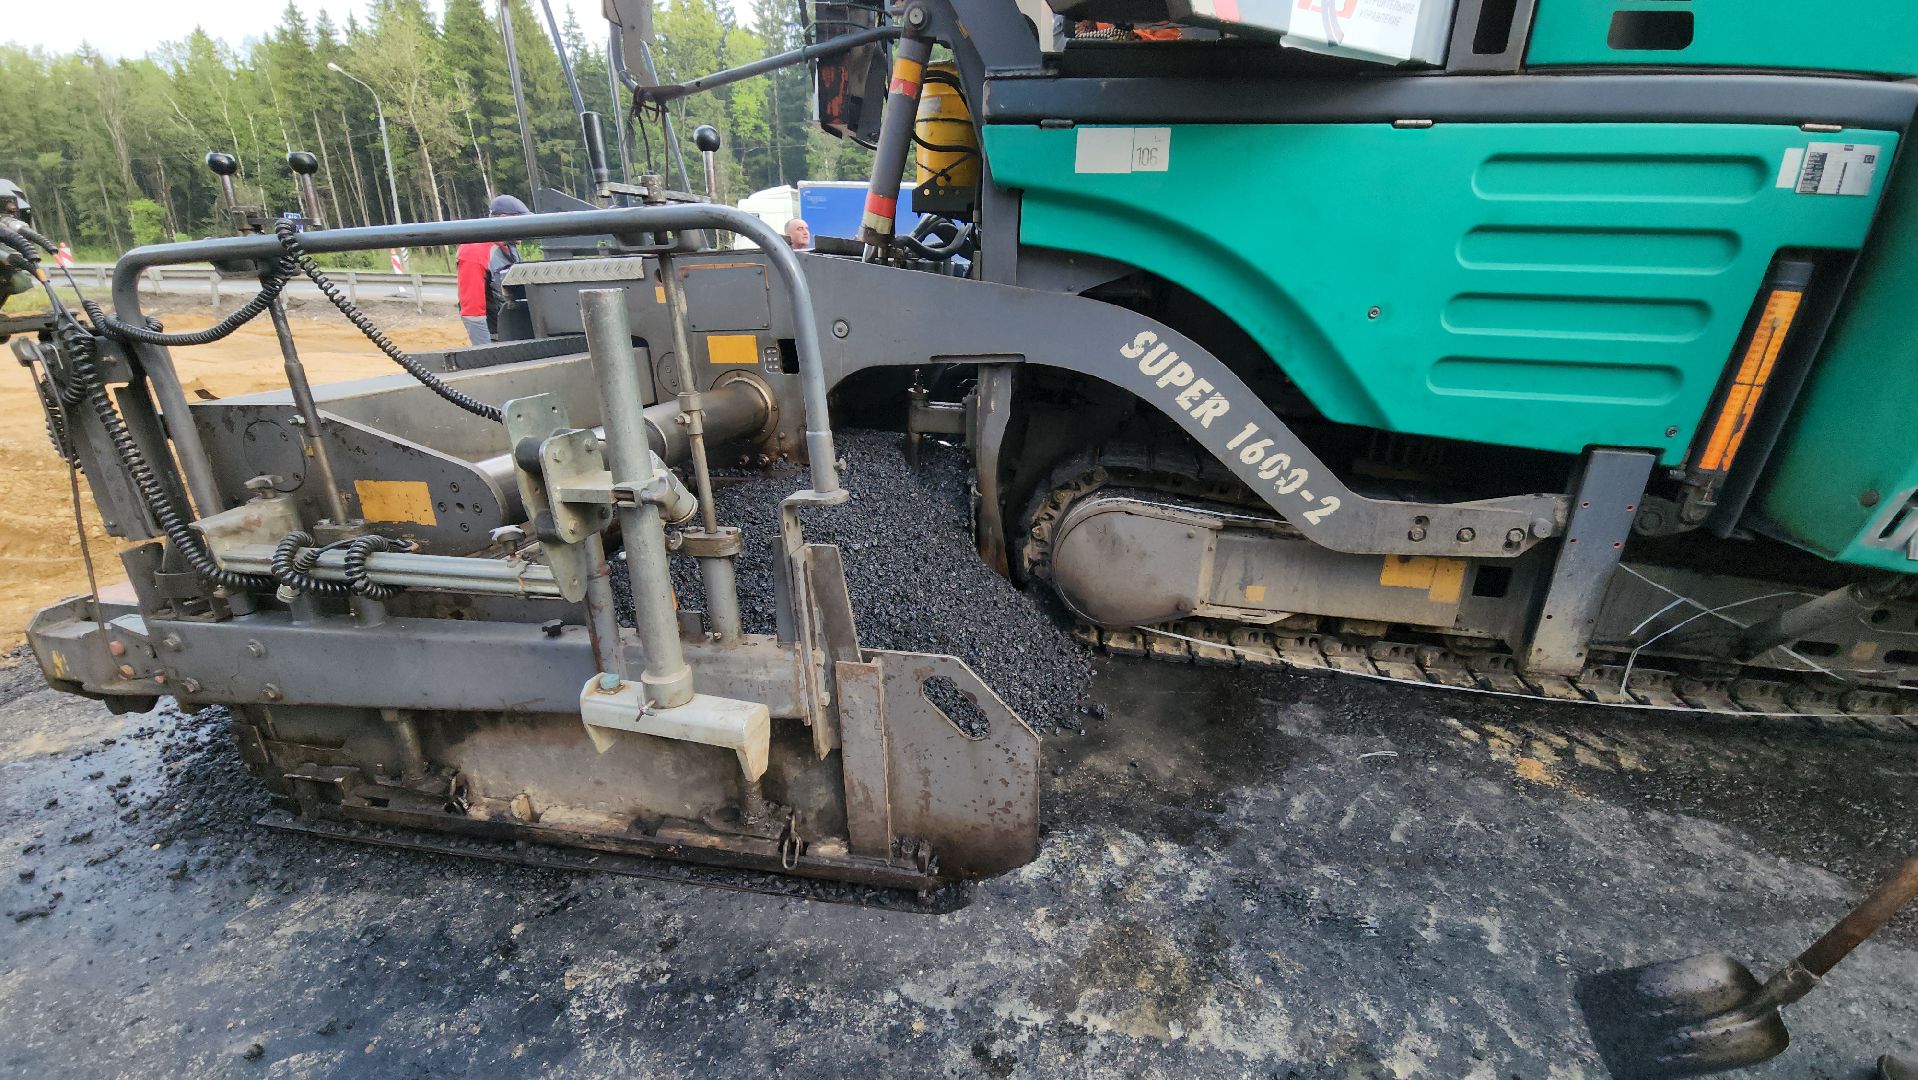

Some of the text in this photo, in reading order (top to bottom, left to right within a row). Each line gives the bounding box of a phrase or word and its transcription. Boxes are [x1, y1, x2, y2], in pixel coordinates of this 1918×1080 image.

[1136, 146, 1159, 167] 106
[1120, 331, 1341, 526] SUPER 1600-2
